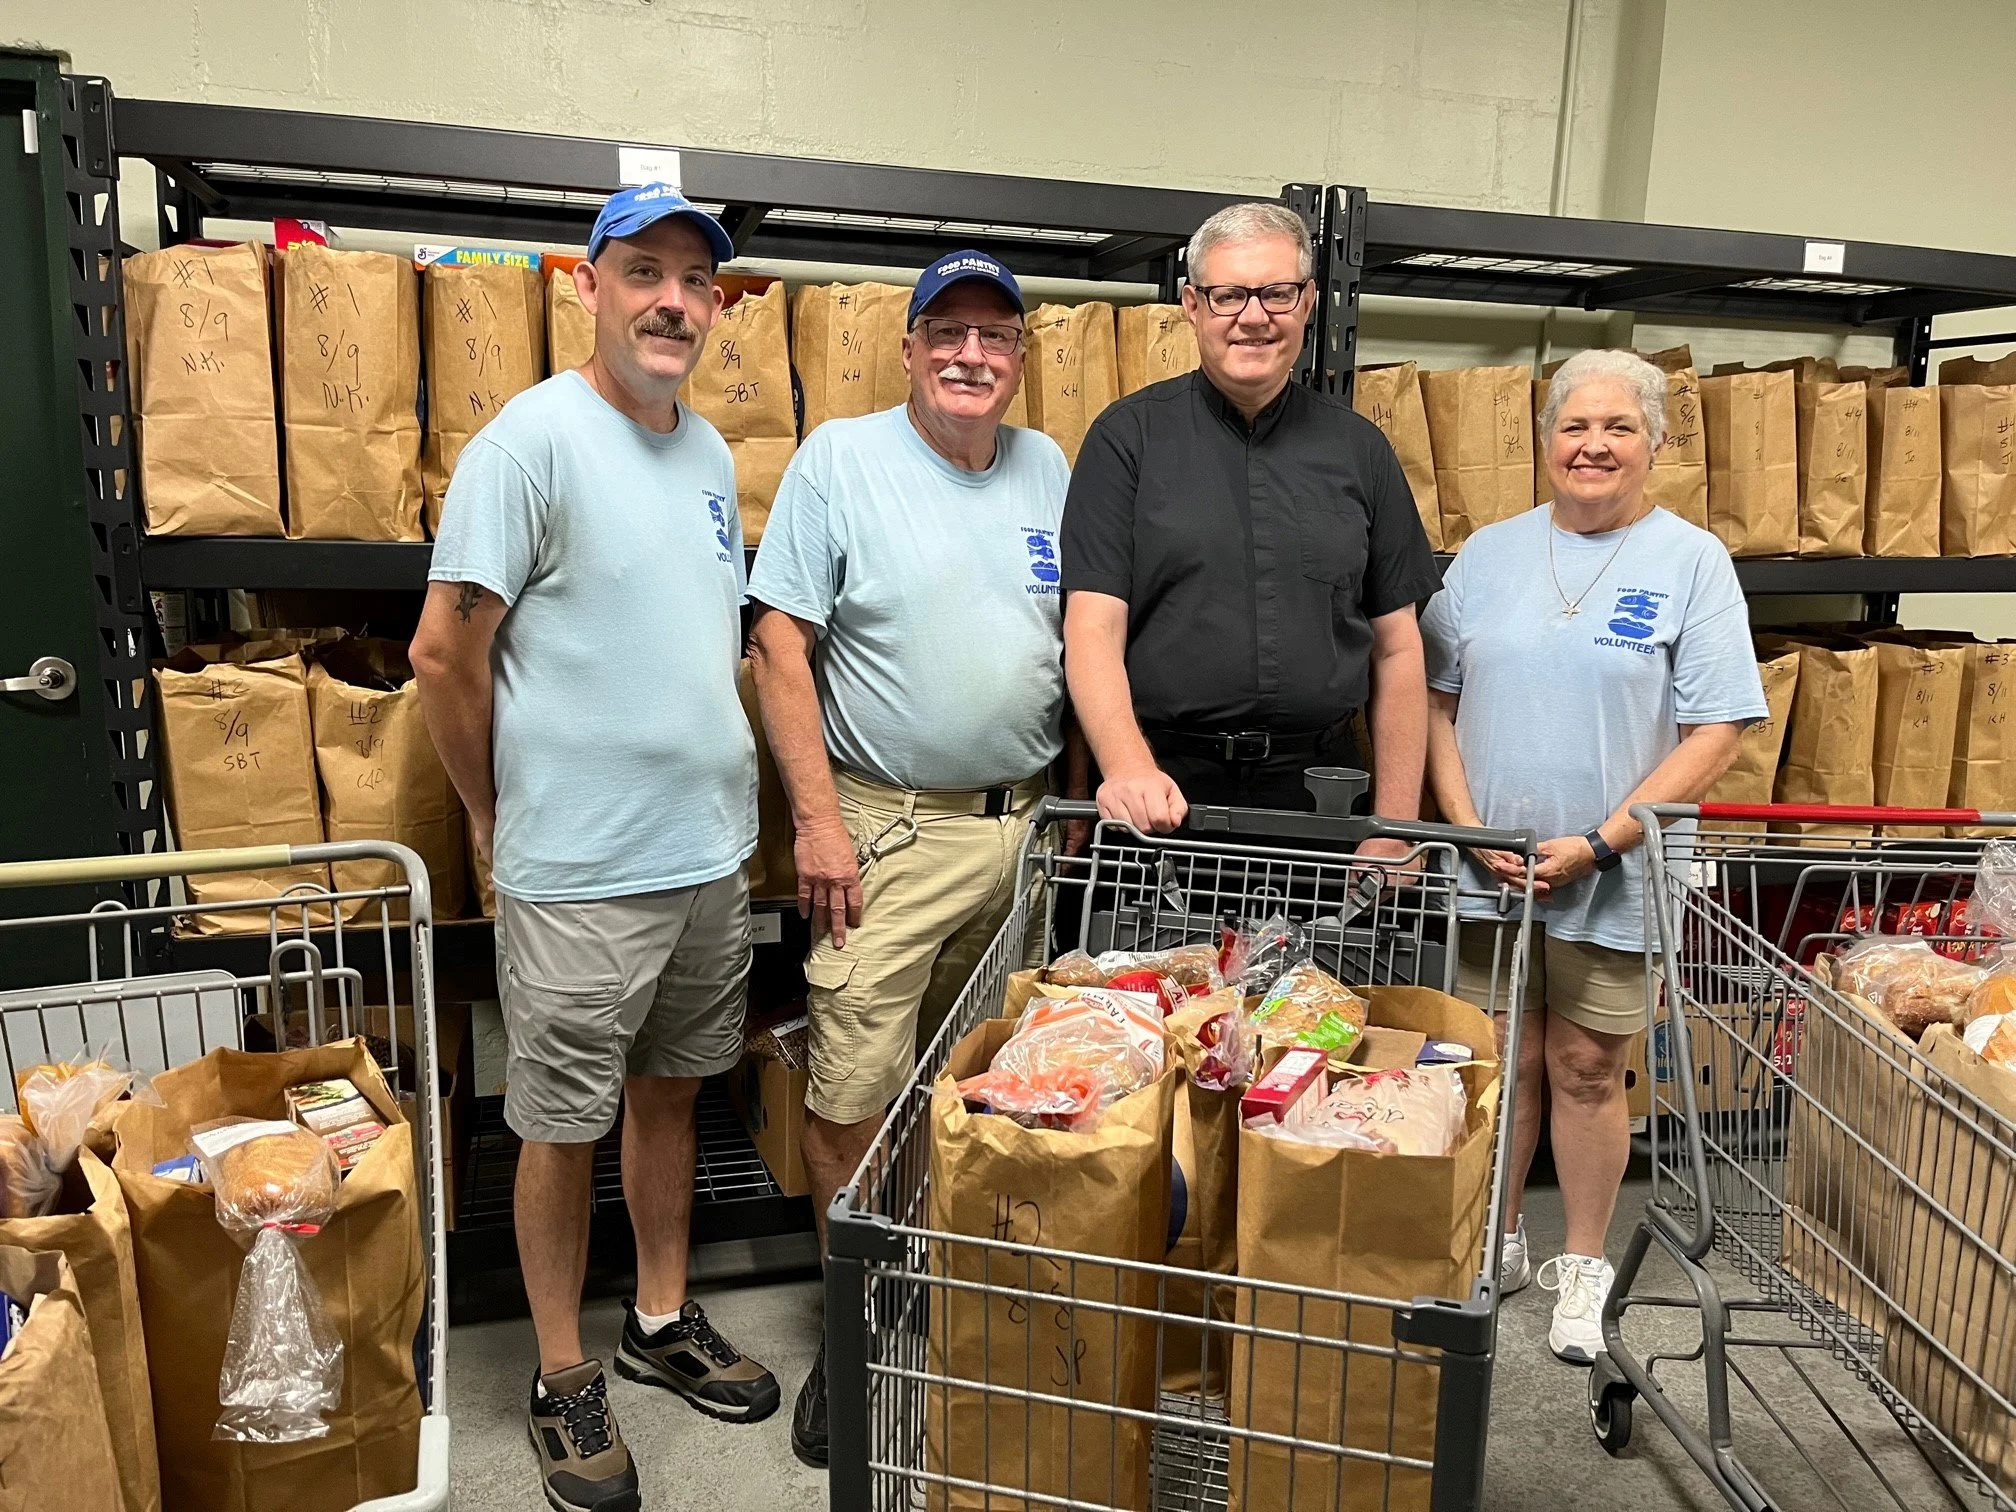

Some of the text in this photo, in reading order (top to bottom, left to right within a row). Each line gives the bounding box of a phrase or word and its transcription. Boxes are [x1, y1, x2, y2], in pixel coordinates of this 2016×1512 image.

[456, 250, 530, 269] FAMILY SIZE
[937, 261, 961, 275] FOOD
[962, 258, 1000, 274] PANTRY
[179, 298, 229, 342] 8/9
[840, 328, 864, 355] 8/11
[317, 329, 360, 386] 8/9
[465, 333, 503, 377] 8/9
[719, 339, 742, 371] 8/9
[1055, 345, 1077, 372] 8/11
[724, 381, 760, 404] SBT
[1679, 403, 1697, 428] 8/9
[1665, 432, 1700, 449] SBT
[1639, 589, 1670, 600] PANTRY
[1593, 636, 1656, 656] VOLUNTEER
[213, 709, 250, 747] 8/9
[355, 734, 385, 762] 8/9
[223, 751, 262, 772] SBT
